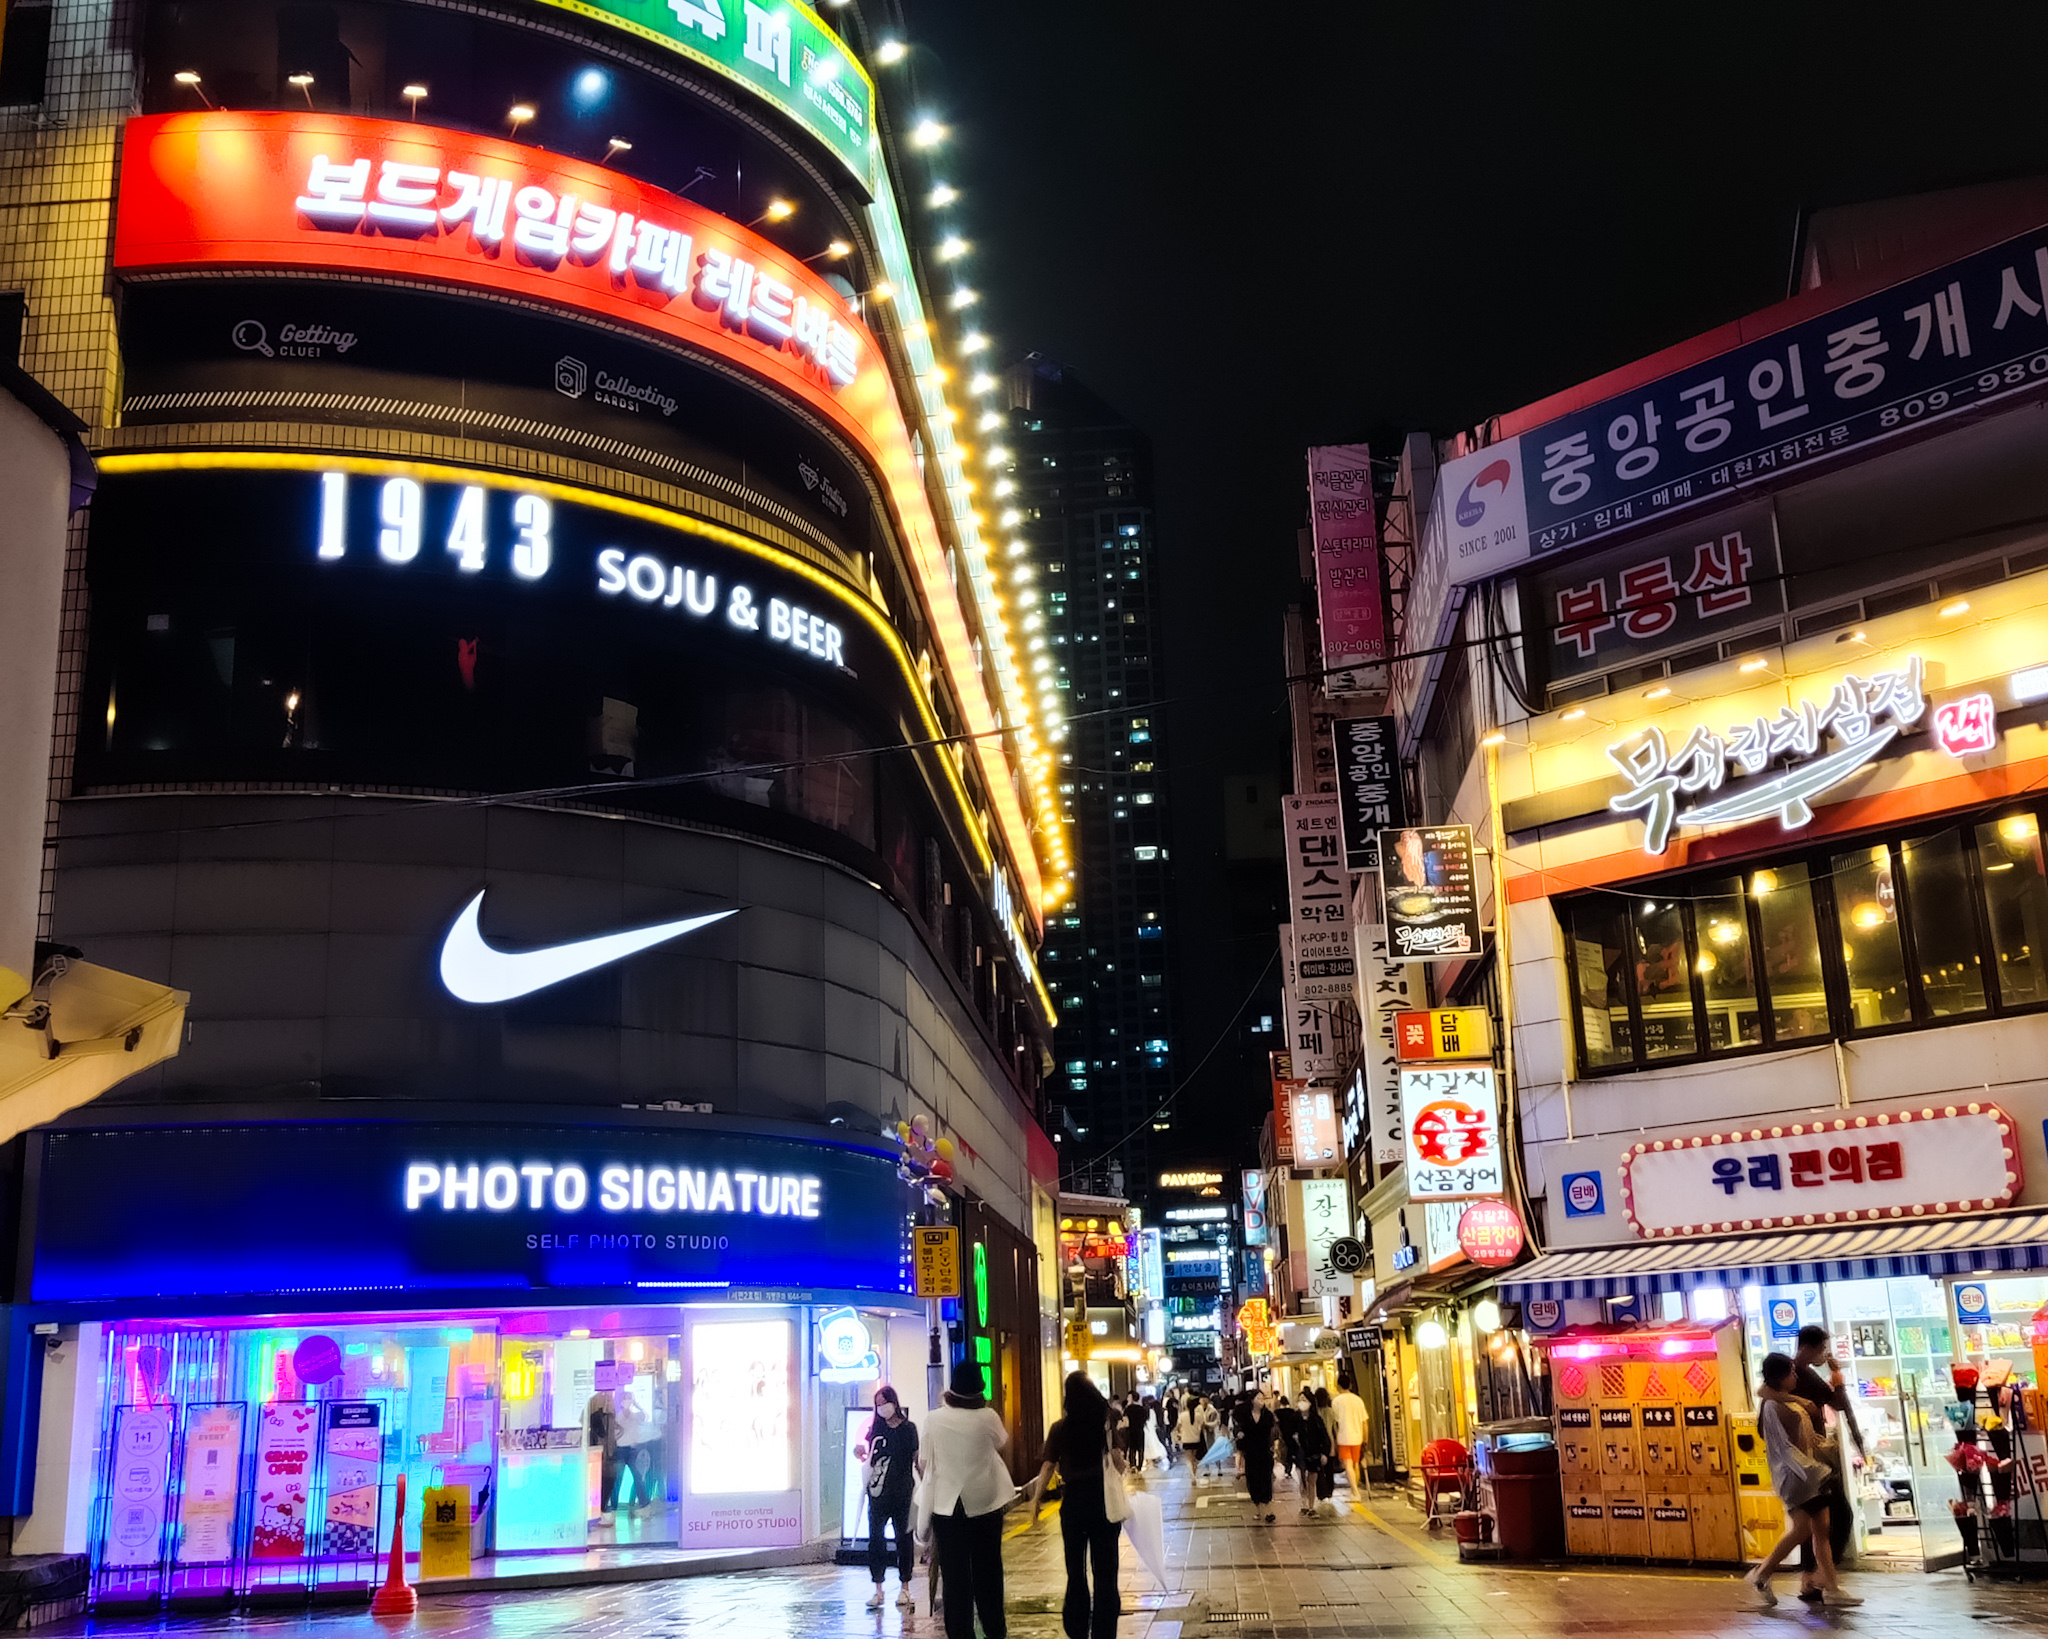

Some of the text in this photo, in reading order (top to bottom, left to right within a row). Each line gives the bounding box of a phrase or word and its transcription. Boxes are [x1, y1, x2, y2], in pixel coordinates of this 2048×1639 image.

[296, 154, 857, 384] 보드게임카페 레드버튼
[279, 323, 358, 352] Getting
[279, 346, 321, 358] CLUE!
[1540, 246, 2048, 506] 중앙공인중개사
[595, 371, 678, 416] Collecting
[1315, 469, 1368, 491] 커플관리
[1539, 521, 1577, 549] 상가
[1594, 502, 1632, 529] 임대
[1652, 480, 1692, 506] 매매
[1711, 425, 1850, 485] 대현지하전문
[1317, 499, 1370, 520] 전신관리
[318, 472, 552, 577] 1943
[1321, 536, 1373, 557] 스톤테라피
[1459, 525, 1516, 558] SINCE 2001
[1329, 567, 1369, 588] 발관리
[1555, 530, 1752, 658] 부동산
[598, 549, 845, 667] SOJU & BEER
[1328, 638, 1382, 652] 802-0616
[1296, 816, 1337, 831] 제트엔
[1299, 834, 1342, 900] 댄스
[1300, 904, 1345, 923] 학원
[1305, 983, 1353, 995] 802-8885
[1298, 1009, 1323, 1055] 카페
[1406, 1024, 1424, 1046] 꽃
[1440, 1013, 1460, 1053] 담배
[1410, 1071, 1486, 1095] 자갈치
[1161, 1172, 1206, 1187] PAVOX
[406, 1166, 821, 1217] PHOTO SIGNATURE
[1243, 1170, 1264, 1229] DVD
[1572, 1185, 1595, 1199] 담배
[1471, 1210, 1509, 1223] 자갈치
[526, 1233, 730, 1251] SELF PHOTO STUDIO
[1531, 1303, 1556, 1316] 담배
[1960, 1293, 1983, 1305] 담배
[1775, 1309, 1794, 1320] 담배
[135, 1432, 151, 1443] 1+1
[265, 1450, 308, 1462] GRAND
[268, 1463, 303, 1475] OPEN
[711, 1508, 773, 1517] remote control
[688, 1518, 797, 1532] SELF PHOTO STUDIO
